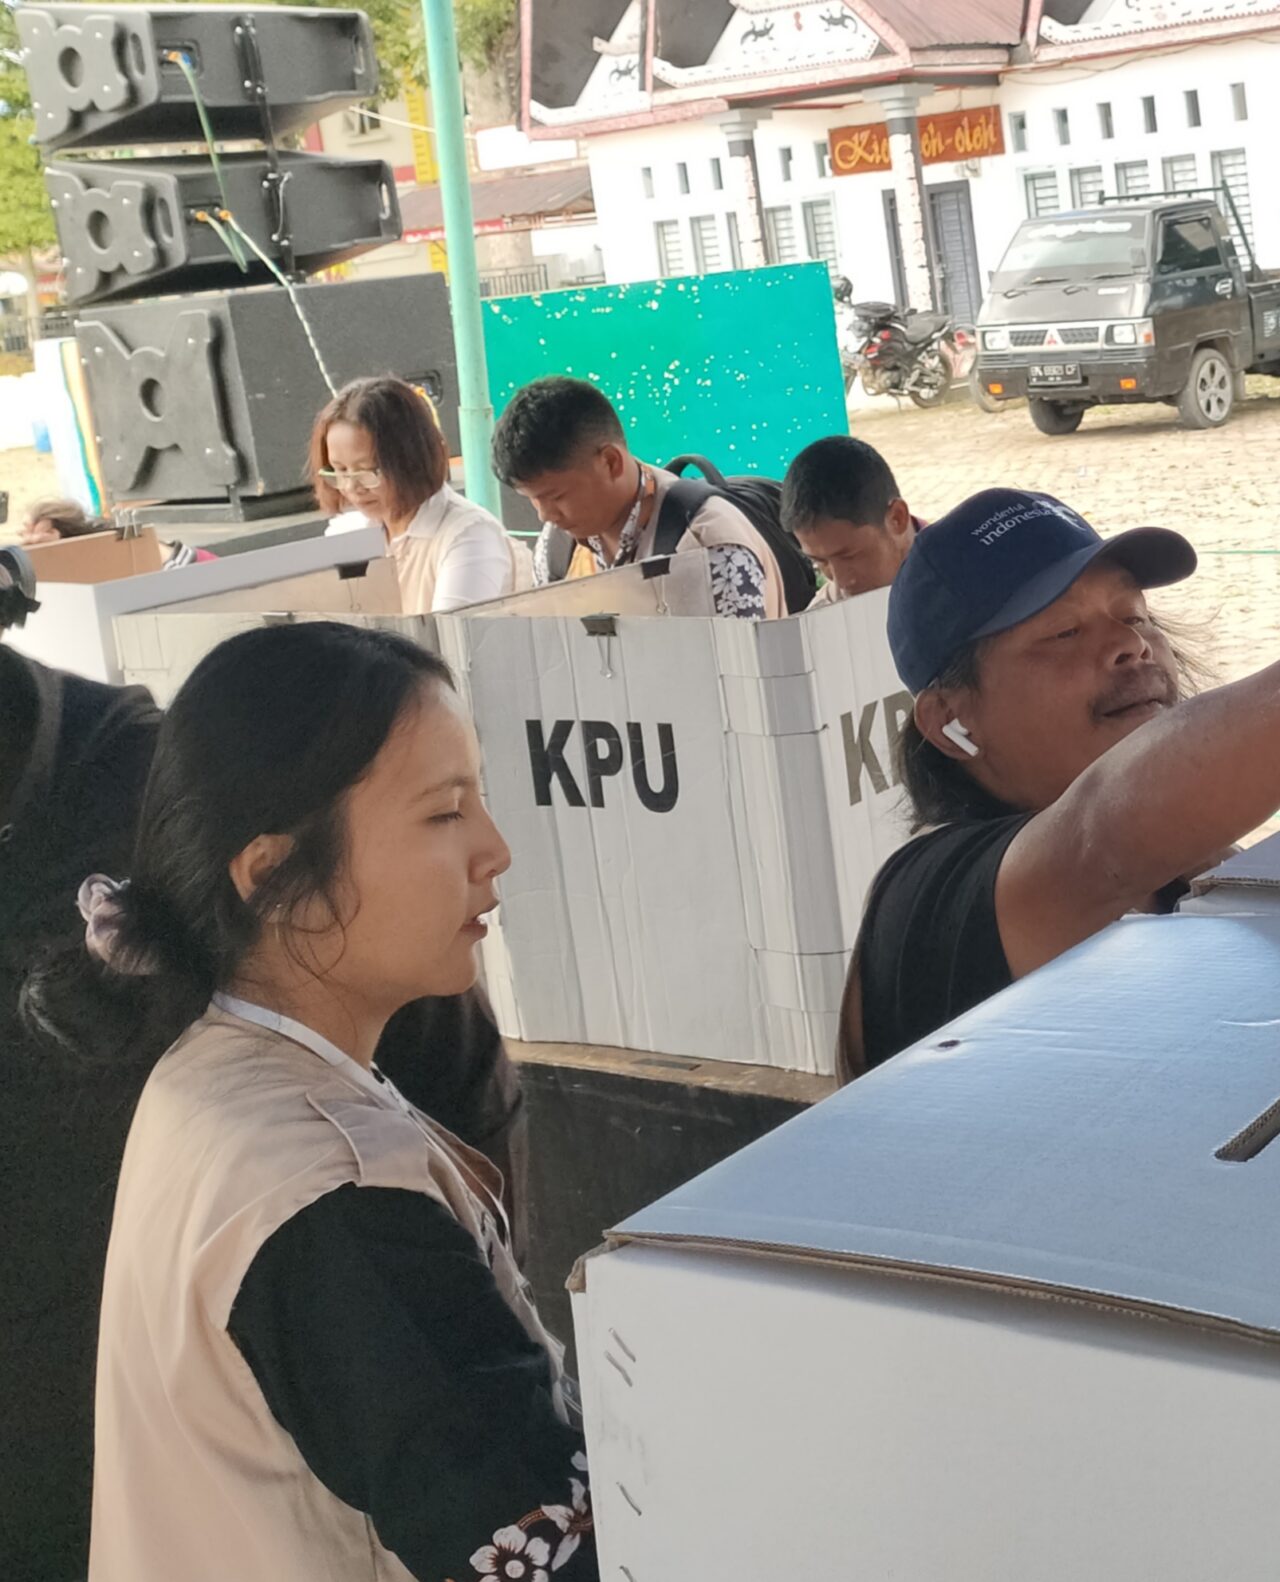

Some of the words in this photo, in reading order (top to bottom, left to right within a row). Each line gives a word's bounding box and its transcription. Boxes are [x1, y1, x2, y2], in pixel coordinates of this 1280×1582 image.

[980, 508, 1052, 546] indonesia
[525, 719, 680, 813] KPU
[840, 690, 916, 806] KP
